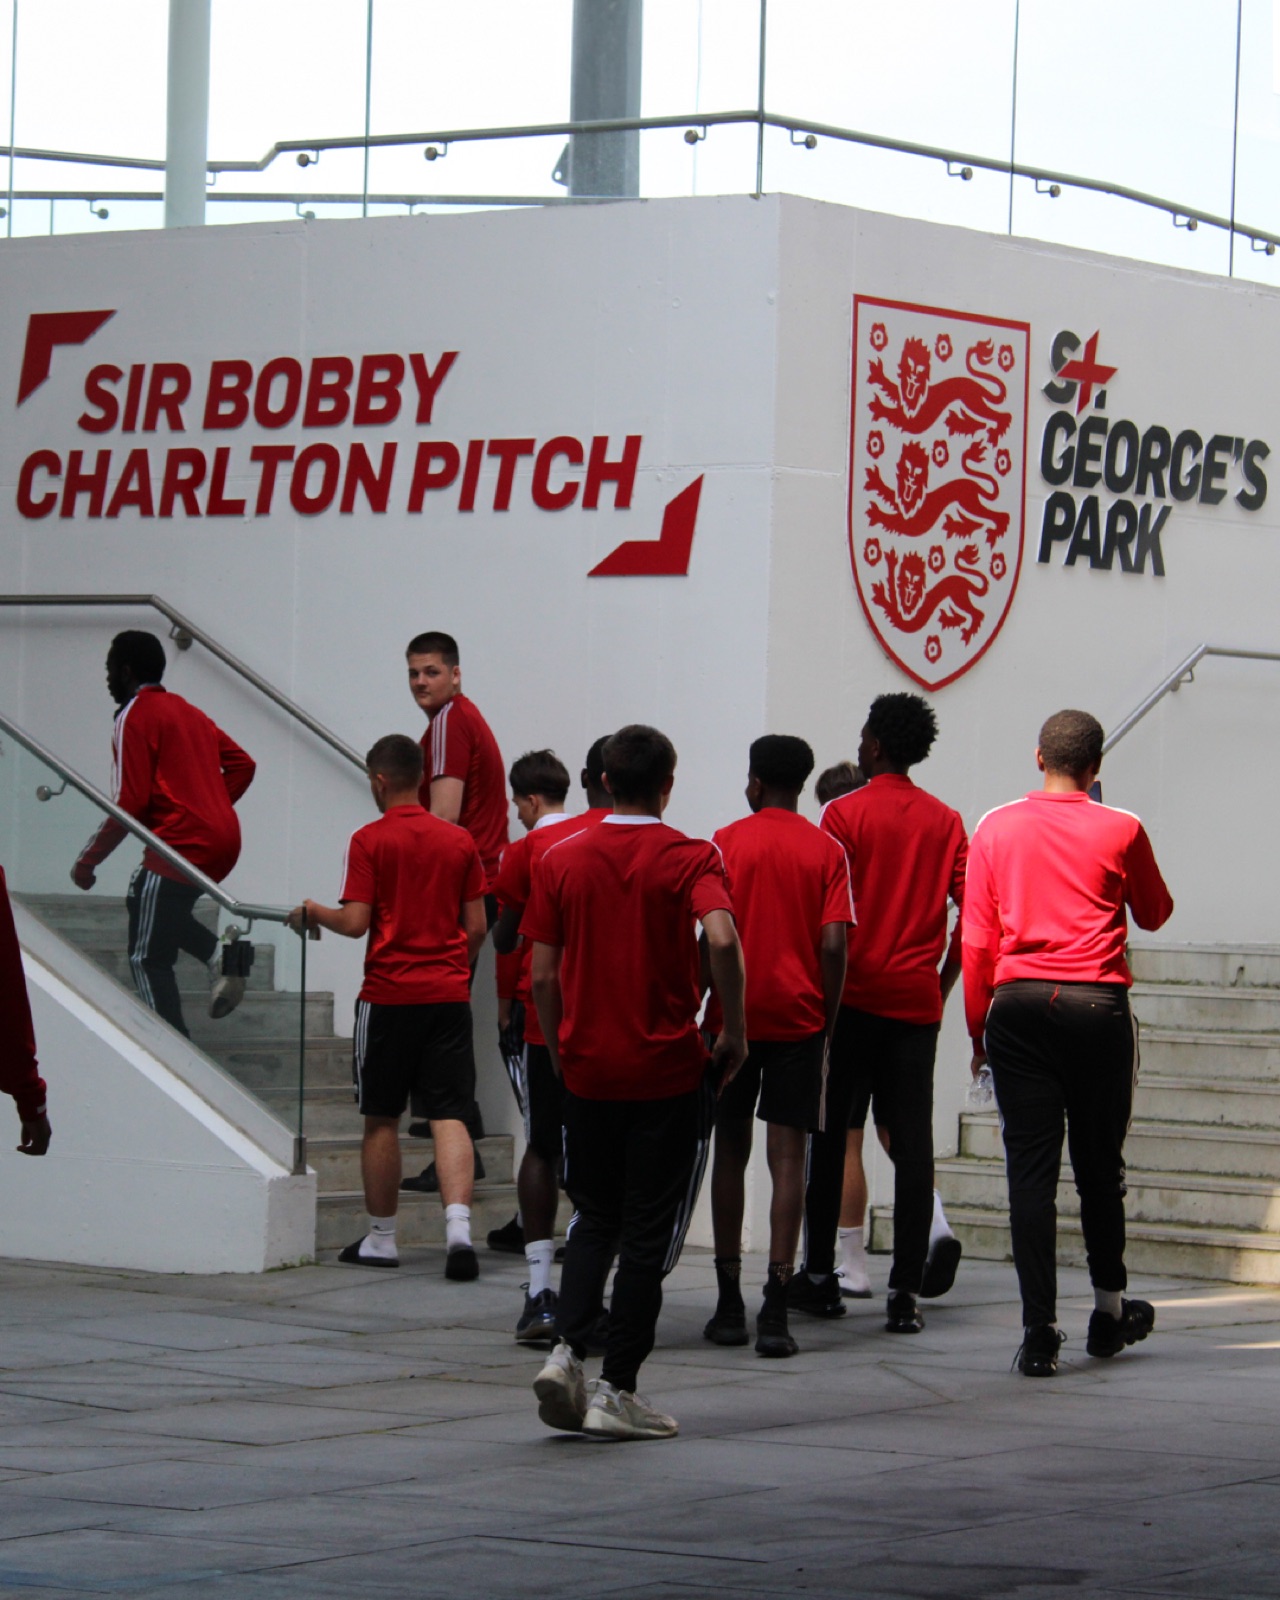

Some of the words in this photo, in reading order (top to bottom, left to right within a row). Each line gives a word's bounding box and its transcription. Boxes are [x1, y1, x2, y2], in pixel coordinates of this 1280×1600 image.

[76, 363, 192, 434] SIR
[202, 351, 460, 430] BOBBY
[15, 441, 398, 519] CHARLTON
[406, 434, 643, 513] PITCH
[1039, 410, 1272, 513] GEORGE'S
[1036, 490, 1174, 578] PARK
